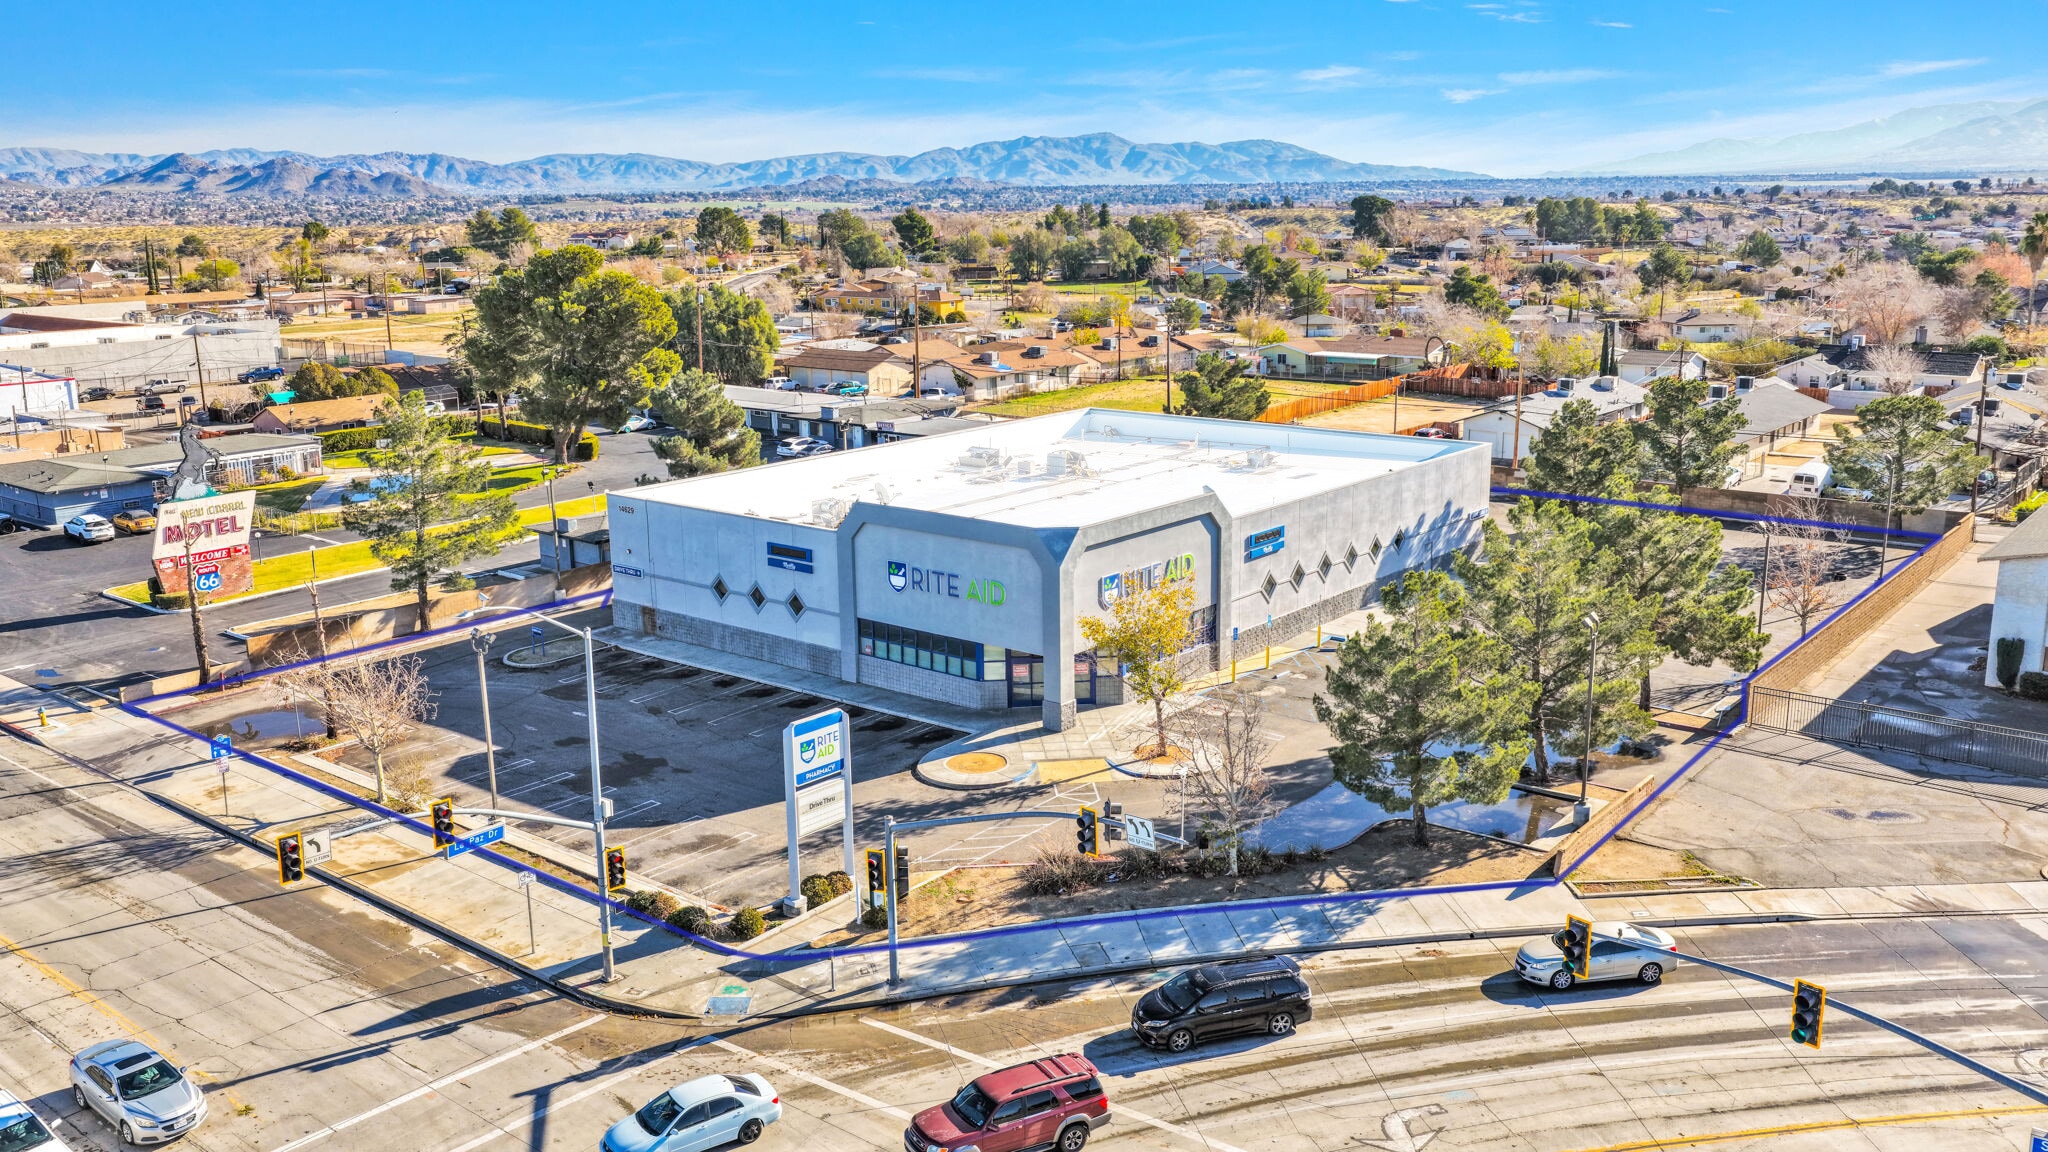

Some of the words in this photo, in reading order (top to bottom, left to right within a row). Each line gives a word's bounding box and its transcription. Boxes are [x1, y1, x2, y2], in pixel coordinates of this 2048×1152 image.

[618, 505, 635, 514] 14629
[163, 515, 244, 545] MOTEL
[1166, 553, 1195, 580] AID
[200, 573, 218, 588] 66
[911, 566, 960, 598] RITE
[966, 578, 1007, 606] AID
[817, 730, 839, 747] RITE
[817, 743, 835, 758] AID
[805, 763, 836, 780] PHARMACY
[809, 799, 823, 810] Drive
[823, 796, 836, 804] Thru
[469, 834, 484, 844] Paz
[488, 829, 498, 839] Dr
